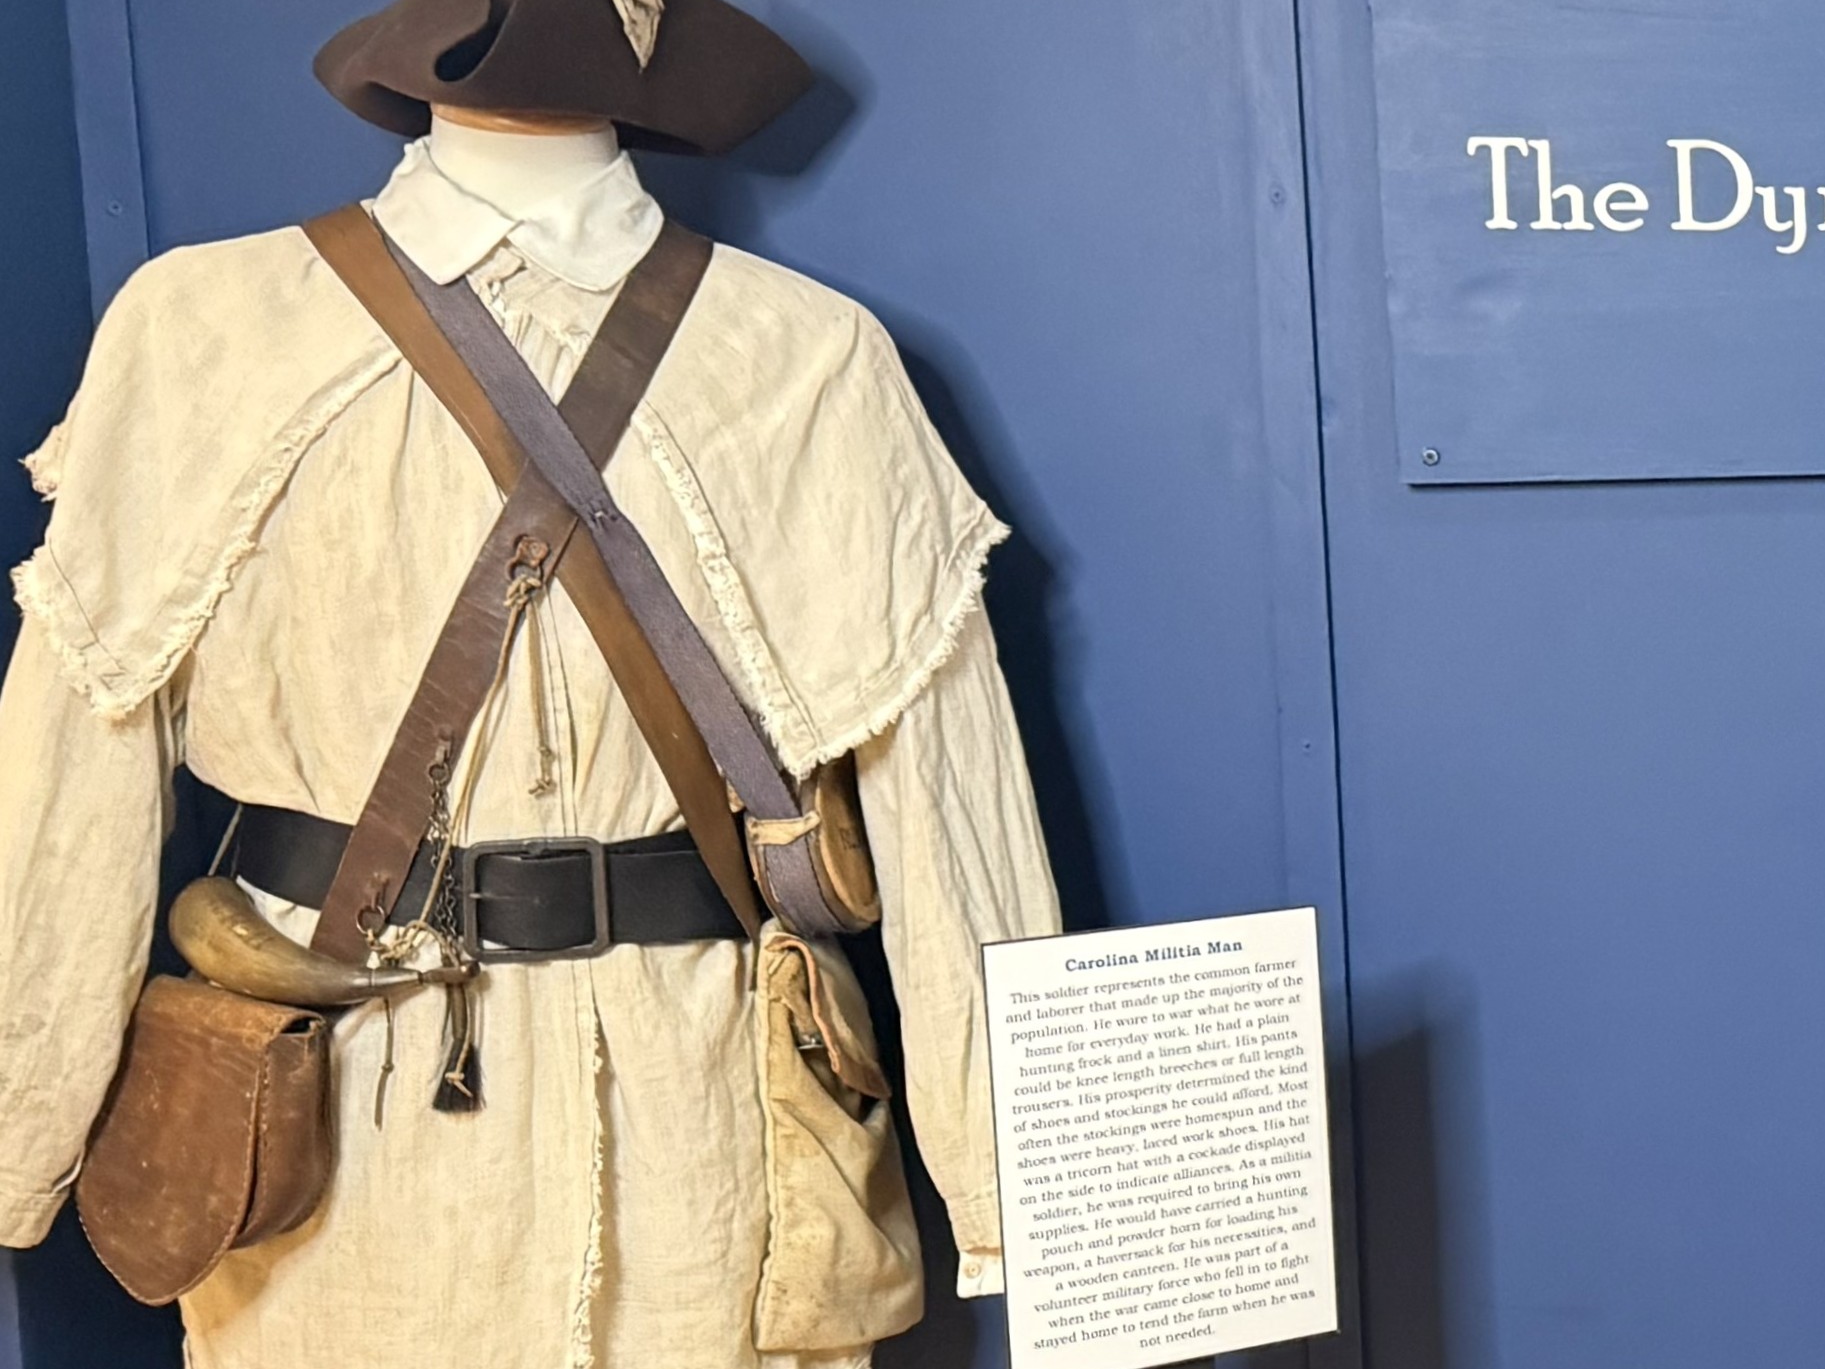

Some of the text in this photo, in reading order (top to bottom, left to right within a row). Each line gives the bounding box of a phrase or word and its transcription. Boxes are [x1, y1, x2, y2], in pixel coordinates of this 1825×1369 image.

[1466, 136, 1649, 232] The
[1063, 940, 1243, 972] Carolina Militia Man
